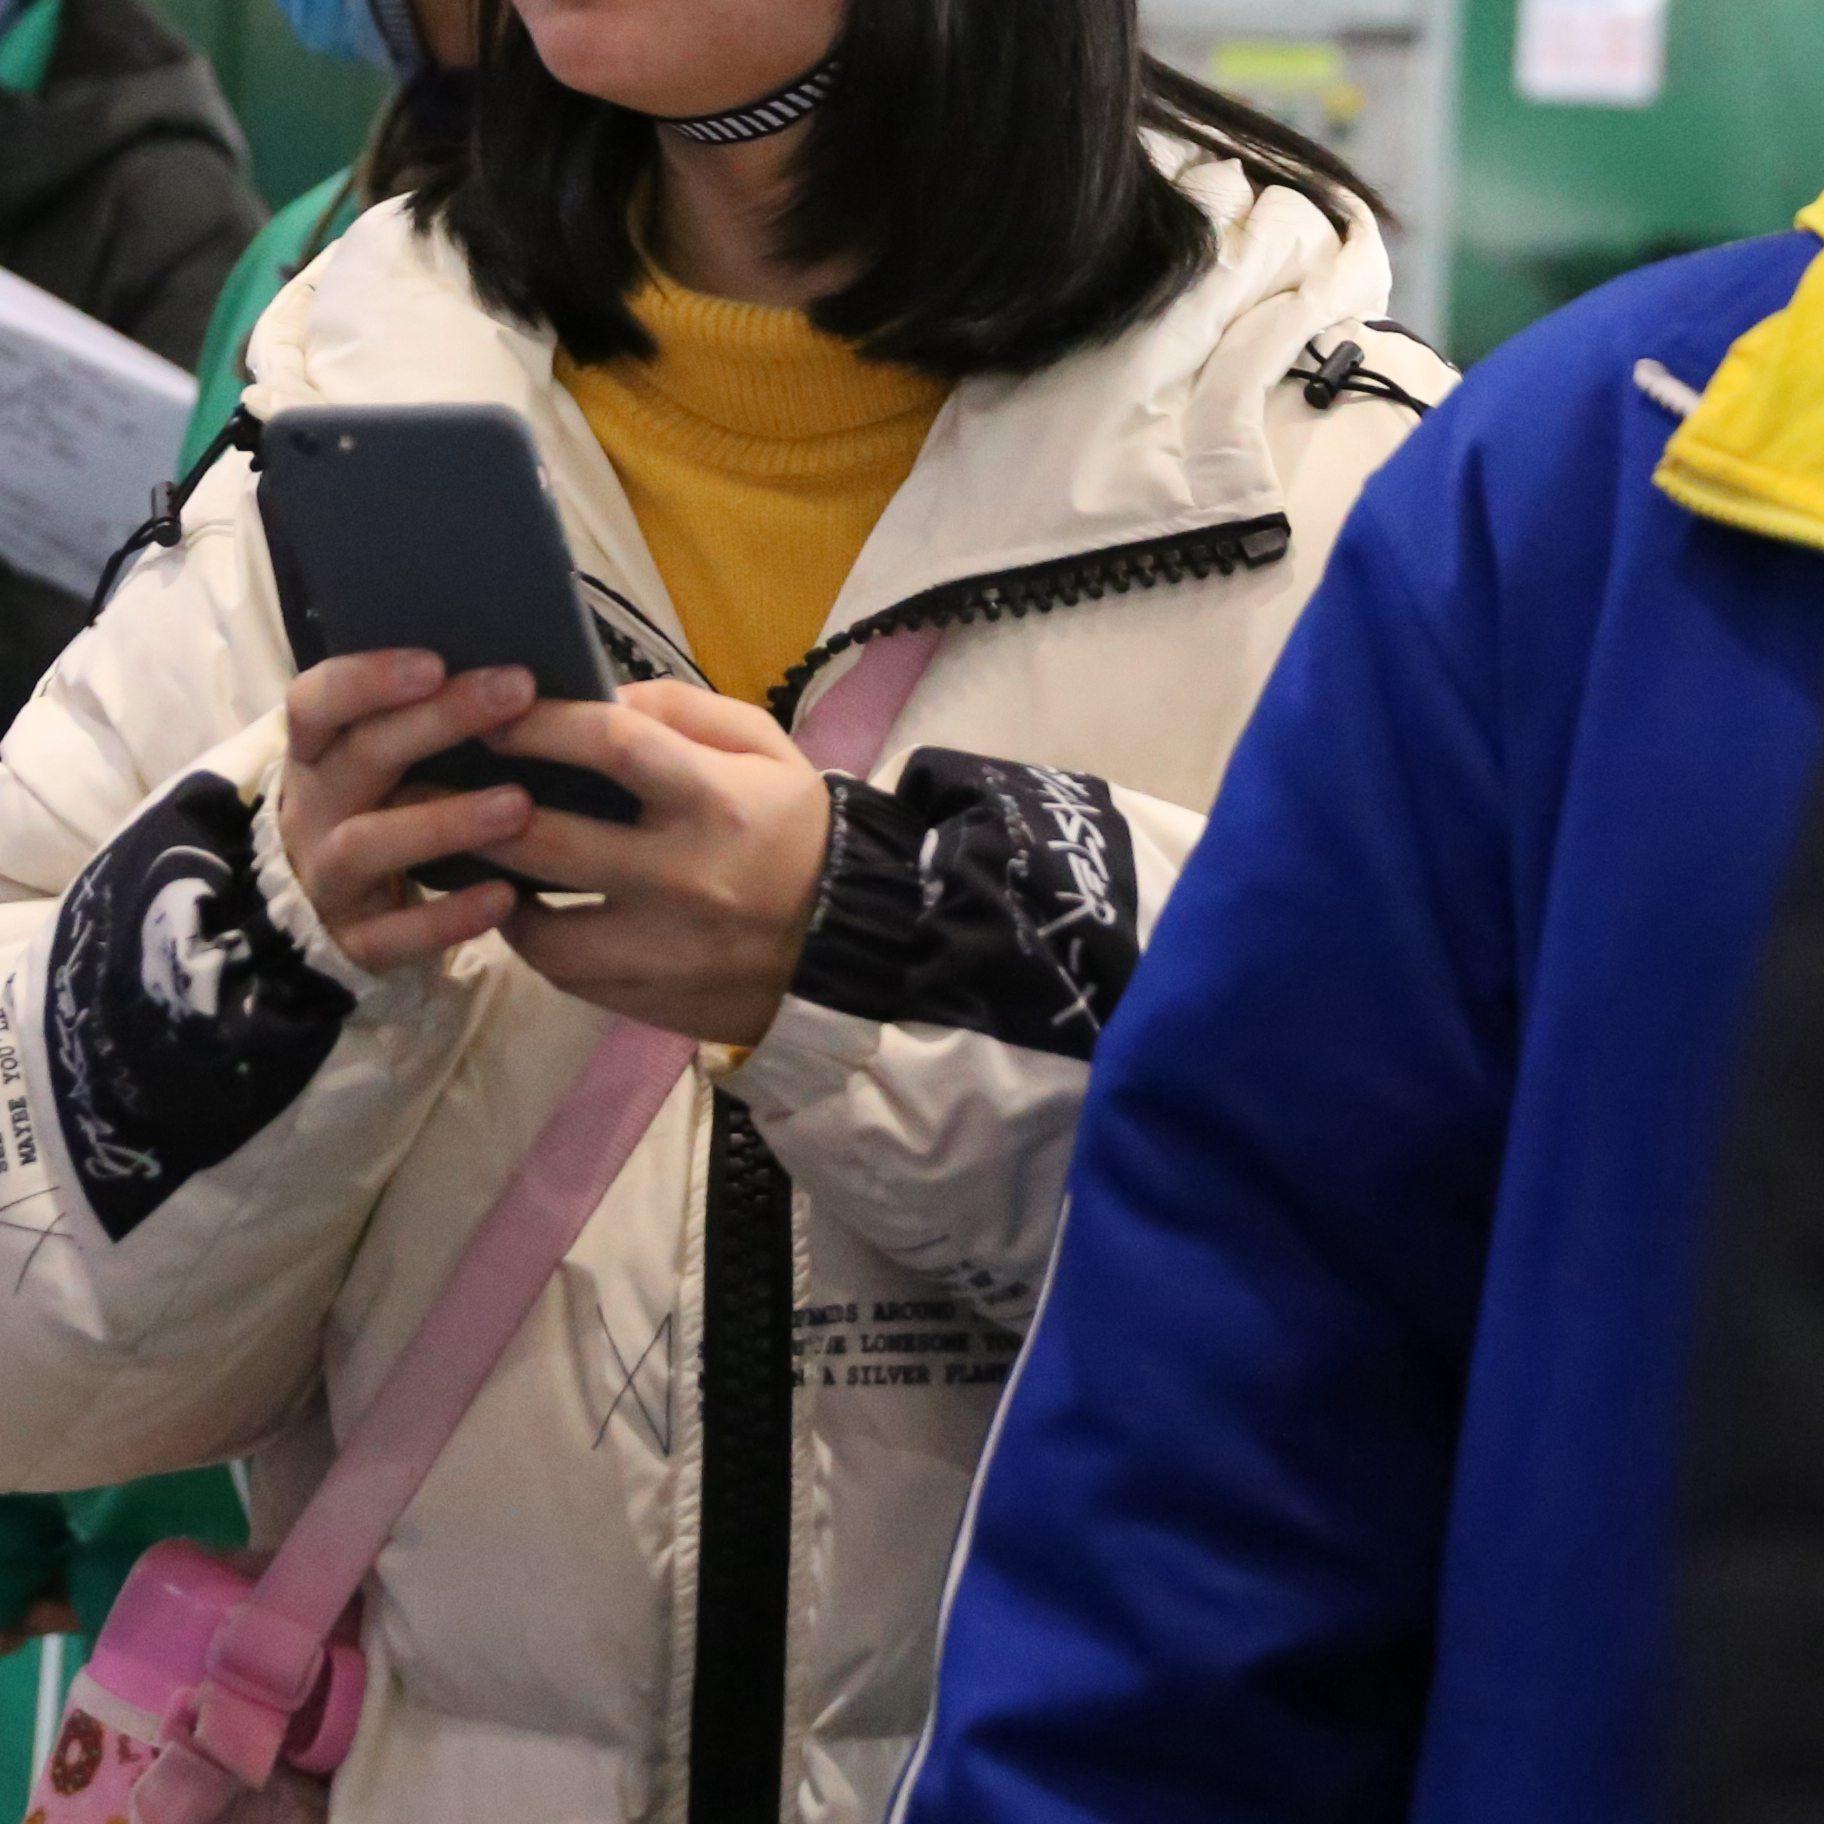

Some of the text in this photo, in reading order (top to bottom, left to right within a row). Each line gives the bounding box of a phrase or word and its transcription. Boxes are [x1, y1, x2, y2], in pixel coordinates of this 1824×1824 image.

[8, 1095, 37, 1166] MAYBE
[822, 1365, 836, 1386] A
[846, 1364, 930, 1386] SILVER
